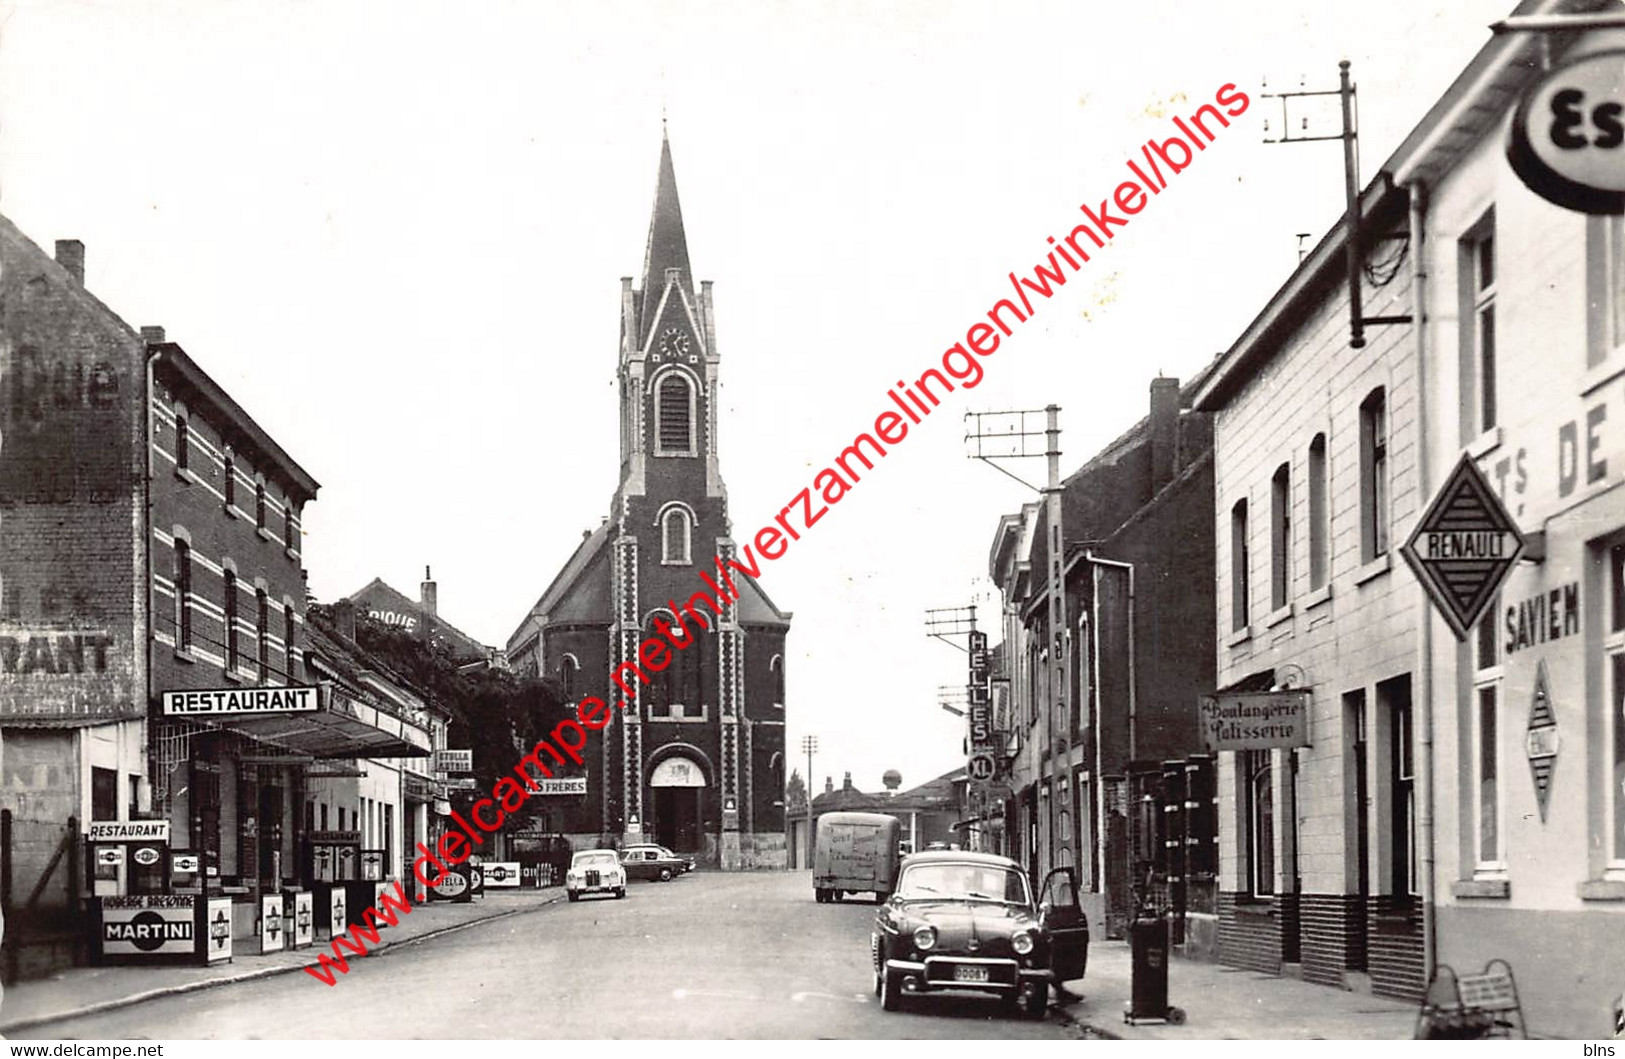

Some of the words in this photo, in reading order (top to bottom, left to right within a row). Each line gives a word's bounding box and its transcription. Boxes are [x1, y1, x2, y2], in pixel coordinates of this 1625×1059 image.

[1558, 403, 1607, 498] DE
[1428, 533, 1506, 559] RENAULT
[971, 635, 987, 740] HELLES
[171, 690, 310, 712] RESTAURANT
[90, 824, 166, 837] RESTAURANT
[484, 870, 516, 878] MARTINI
[106, 923, 190, 939] MARTINI
